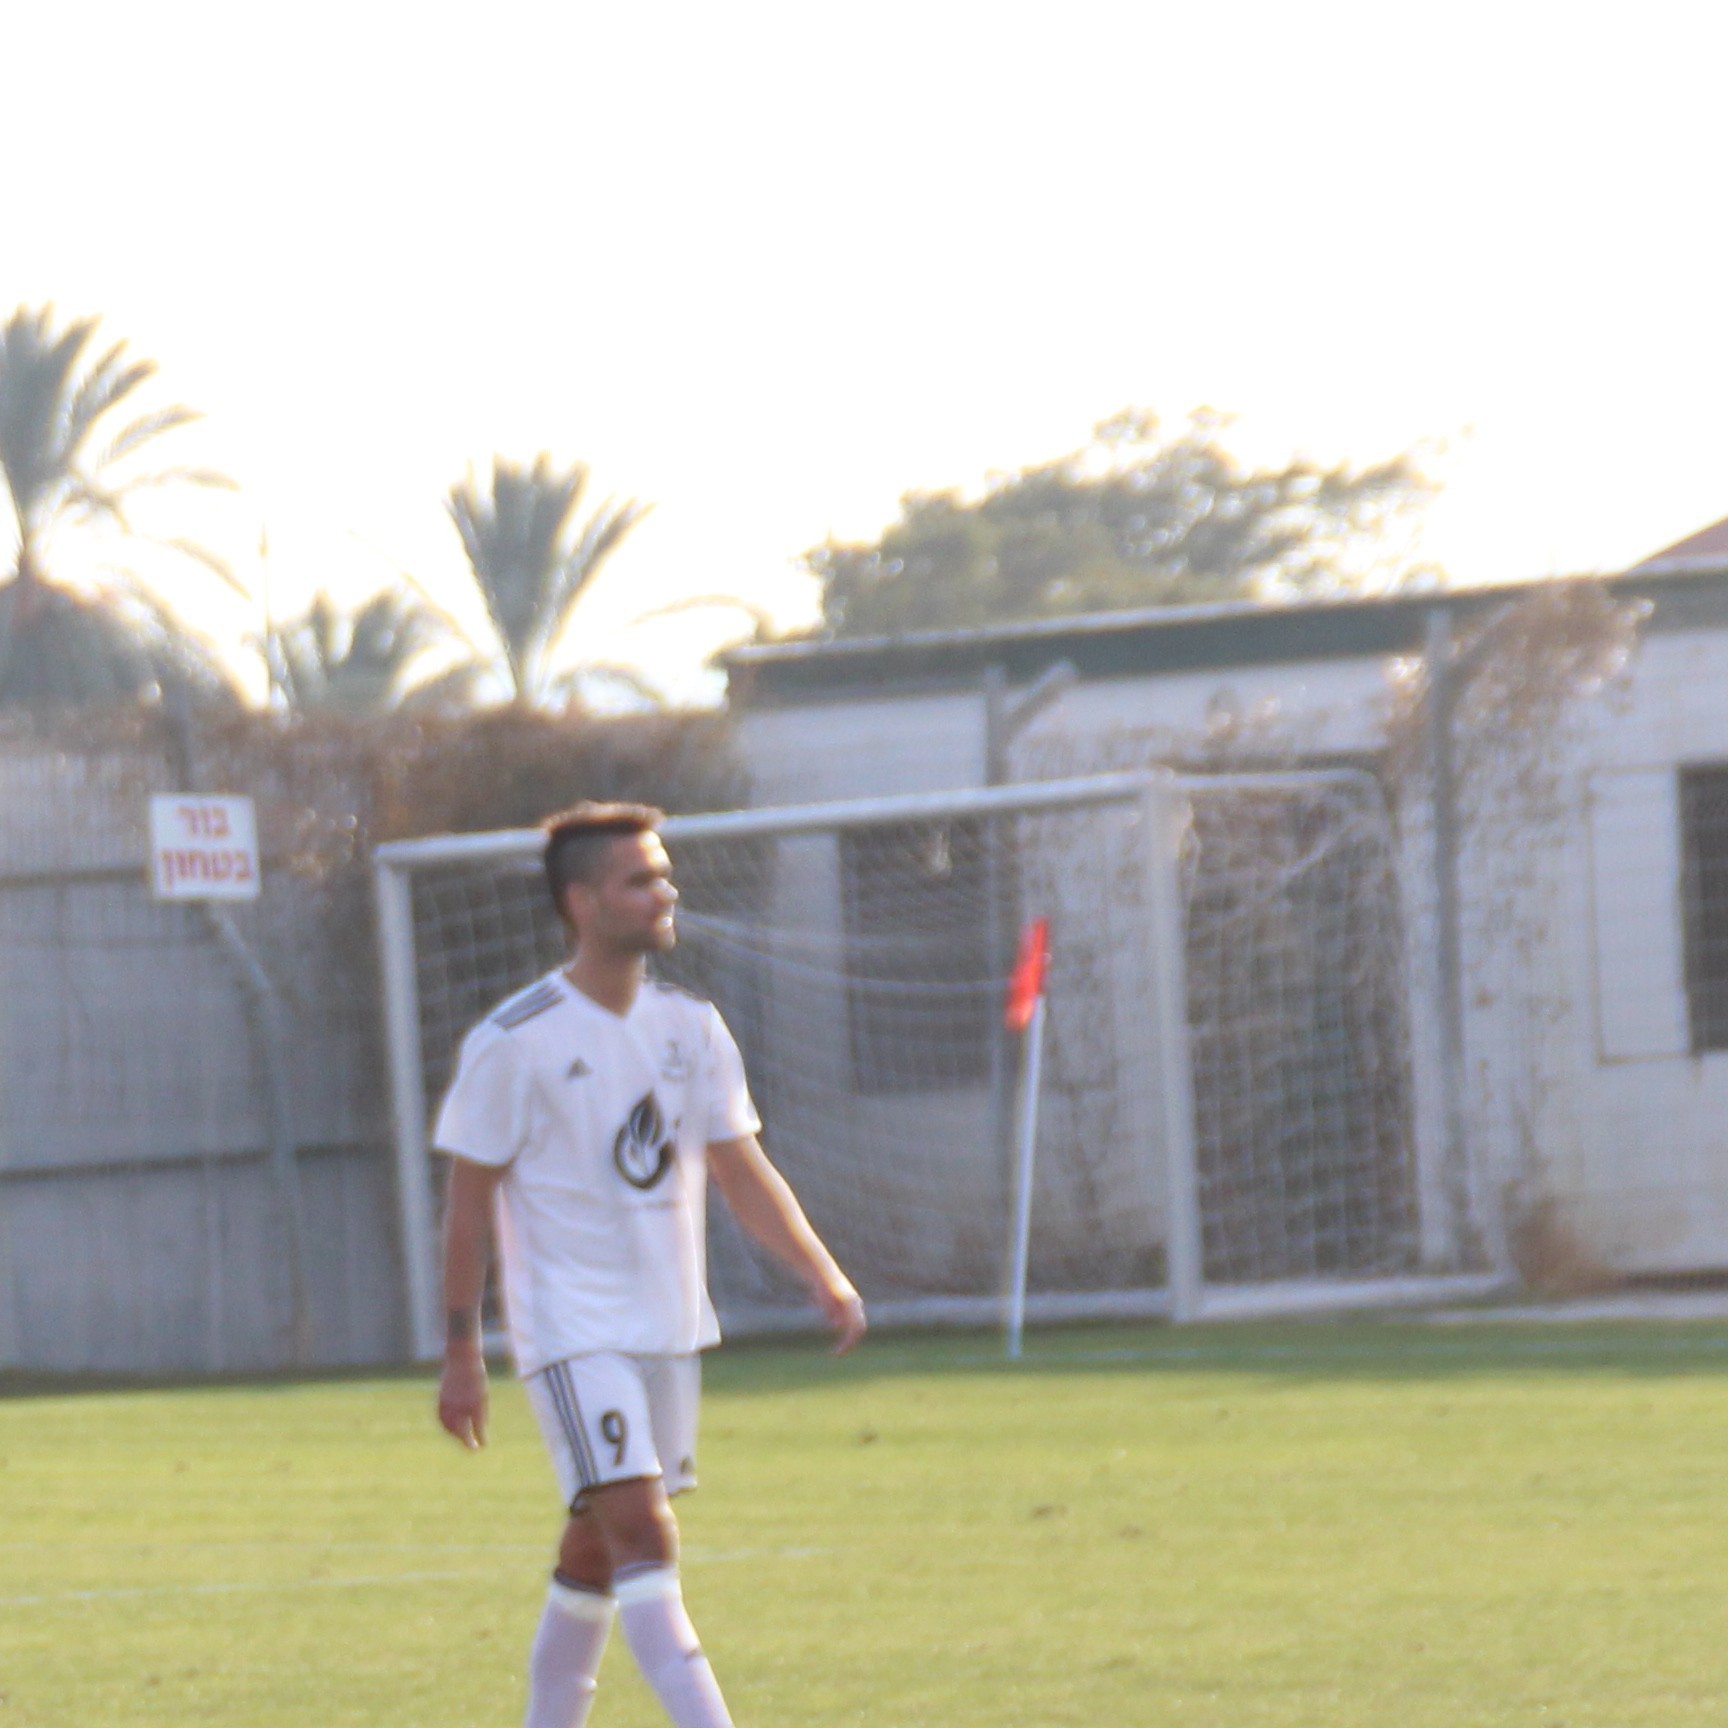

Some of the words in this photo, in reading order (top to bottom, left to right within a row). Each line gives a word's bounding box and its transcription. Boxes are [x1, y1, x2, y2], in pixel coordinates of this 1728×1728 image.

[176, 805, 230, 838] בור
[160, 849, 252, 889] בטחון
[600, 1409, 628, 1467] 9
